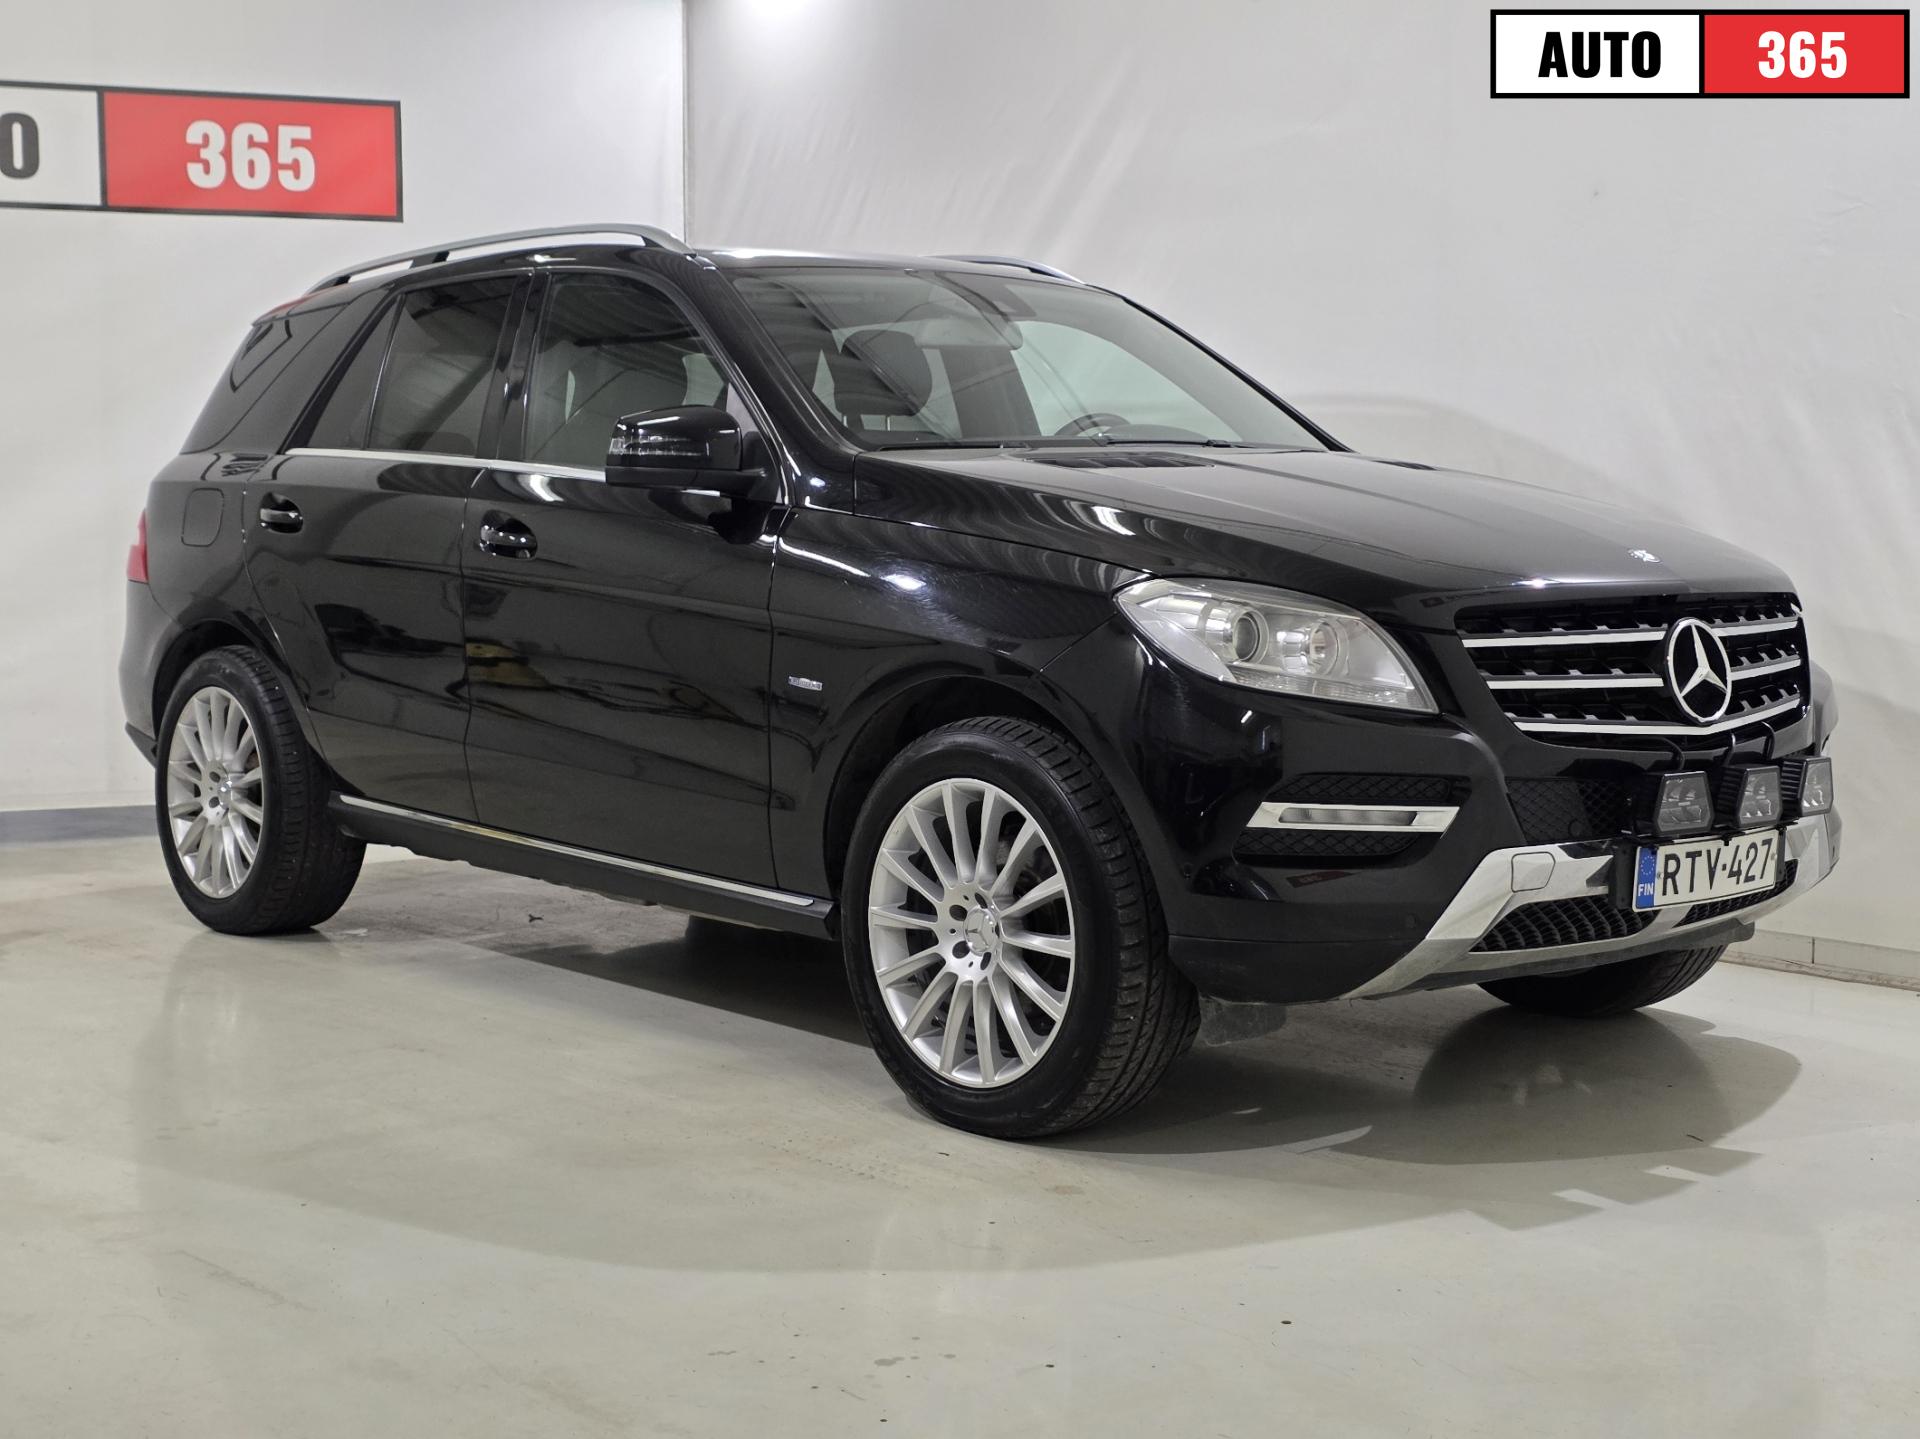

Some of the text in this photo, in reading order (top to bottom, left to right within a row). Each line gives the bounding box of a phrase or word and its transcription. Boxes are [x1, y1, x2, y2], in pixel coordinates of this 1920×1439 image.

[185, 120, 316, 192] 365
[1637, 838, 1774, 897] FIN RTV-427
